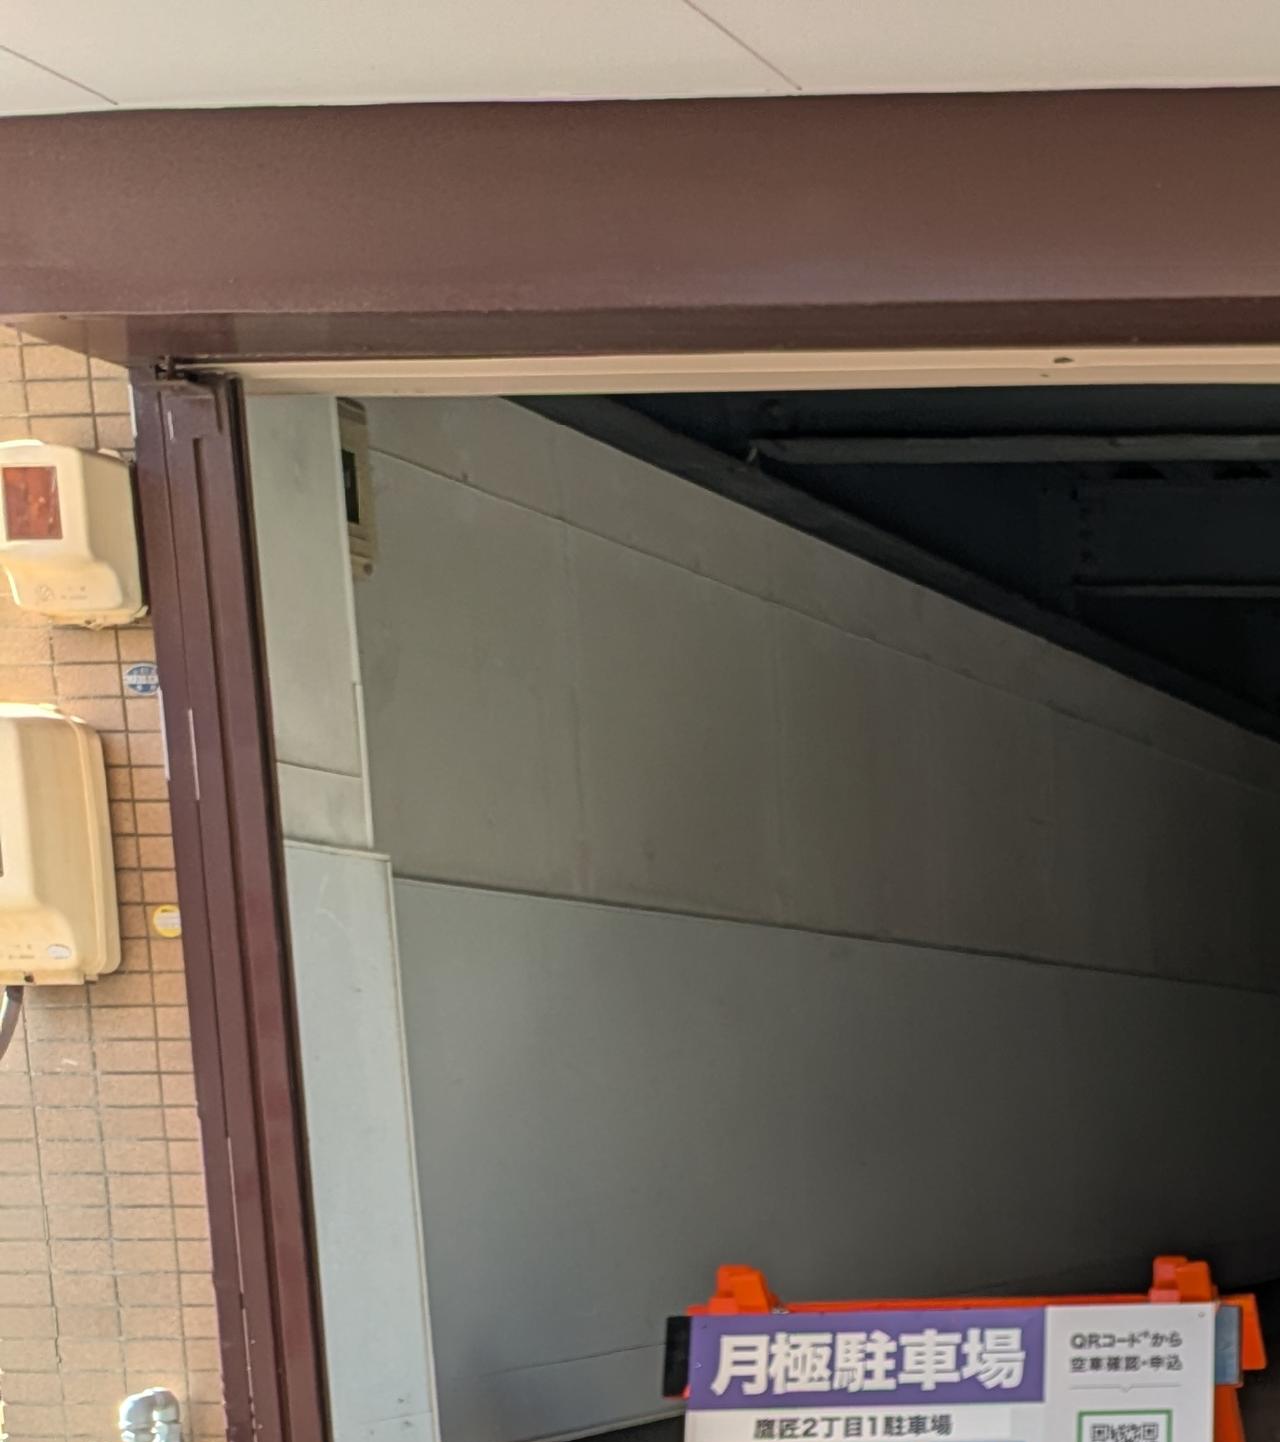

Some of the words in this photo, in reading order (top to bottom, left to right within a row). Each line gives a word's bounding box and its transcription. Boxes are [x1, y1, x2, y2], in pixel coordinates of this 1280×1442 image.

[711, 1327, 1026, 1396] 月極駐車場
[754, 1414, 953, 1440] 鷹匠2丁目1駐車場
